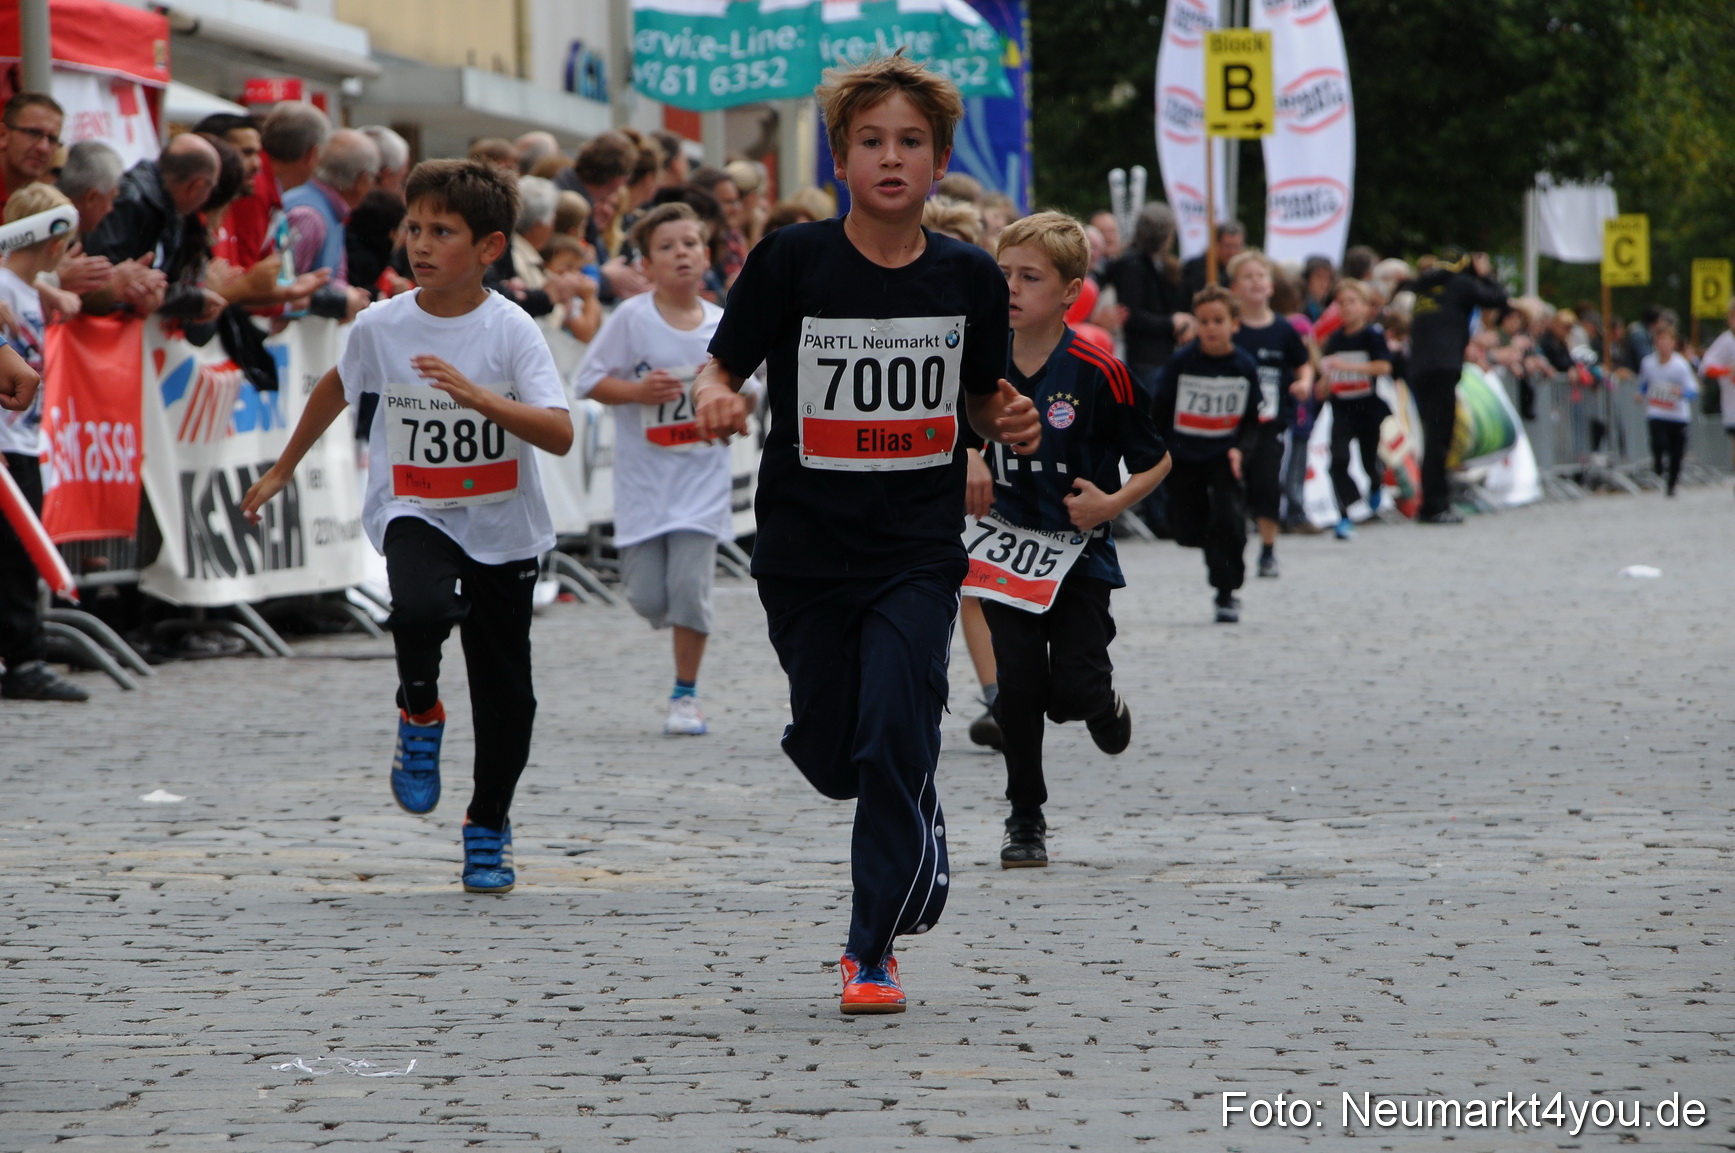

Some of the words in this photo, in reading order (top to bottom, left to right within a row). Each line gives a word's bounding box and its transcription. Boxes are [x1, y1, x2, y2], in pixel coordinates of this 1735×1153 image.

[1211, 35, 1264, 52] Block
[708, 56, 789, 96] 6352
[1224, 64, 1255, 112] B
[1612, 236, 1635, 269] C
[1702, 276, 1722, 303] D
[804, 333, 858, 349] PARTL
[863, 334, 940, 349] Neumarkt
[817, 355, 946, 413] 7000
[387, 396, 427, 411] PARTL
[806, 405, 813, 415] 6
[945, 402, 952, 413] M
[1185, 390, 1237, 414] 7310
[401, 418, 505, 464] 7380
[857, 428, 913, 452] Elias
[967, 520, 1064, 578] 7305
